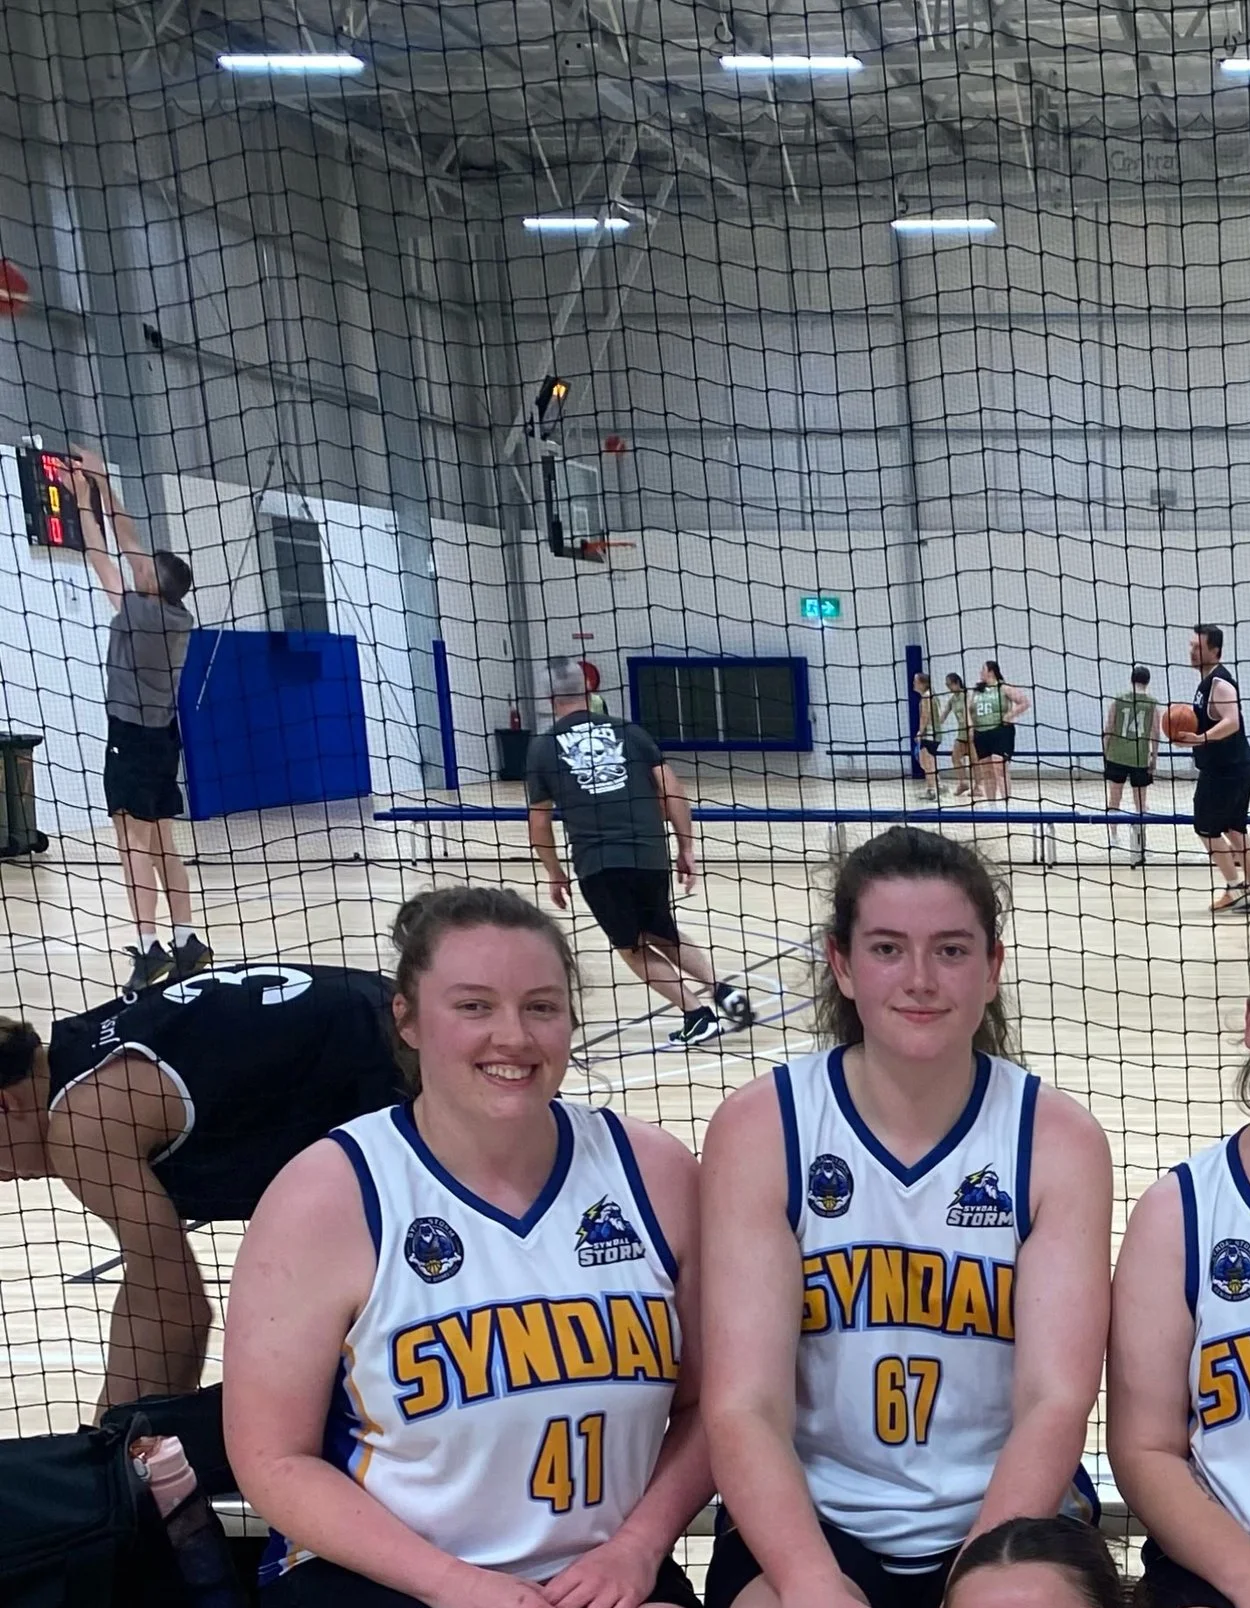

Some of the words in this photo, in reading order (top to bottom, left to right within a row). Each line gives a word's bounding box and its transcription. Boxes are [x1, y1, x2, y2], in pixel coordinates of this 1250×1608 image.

[976, 703, 993, 716] 26
[1120, 707, 1145, 737] 14
[162, 966, 313, 1005] 3
[947, 1209, 1014, 1227] STORM
[962, 1205, 998, 1213] SYNDAL
[579, 1242, 646, 1266] STORM
[593, 1237, 630, 1250] SYNDAL
[801, 1244, 1016, 1343] SYNDAL
[391, 1295, 680, 1422] SYNDAL
[874, 1356, 941, 1446] 67
[530, 1412, 605, 1513] 41
